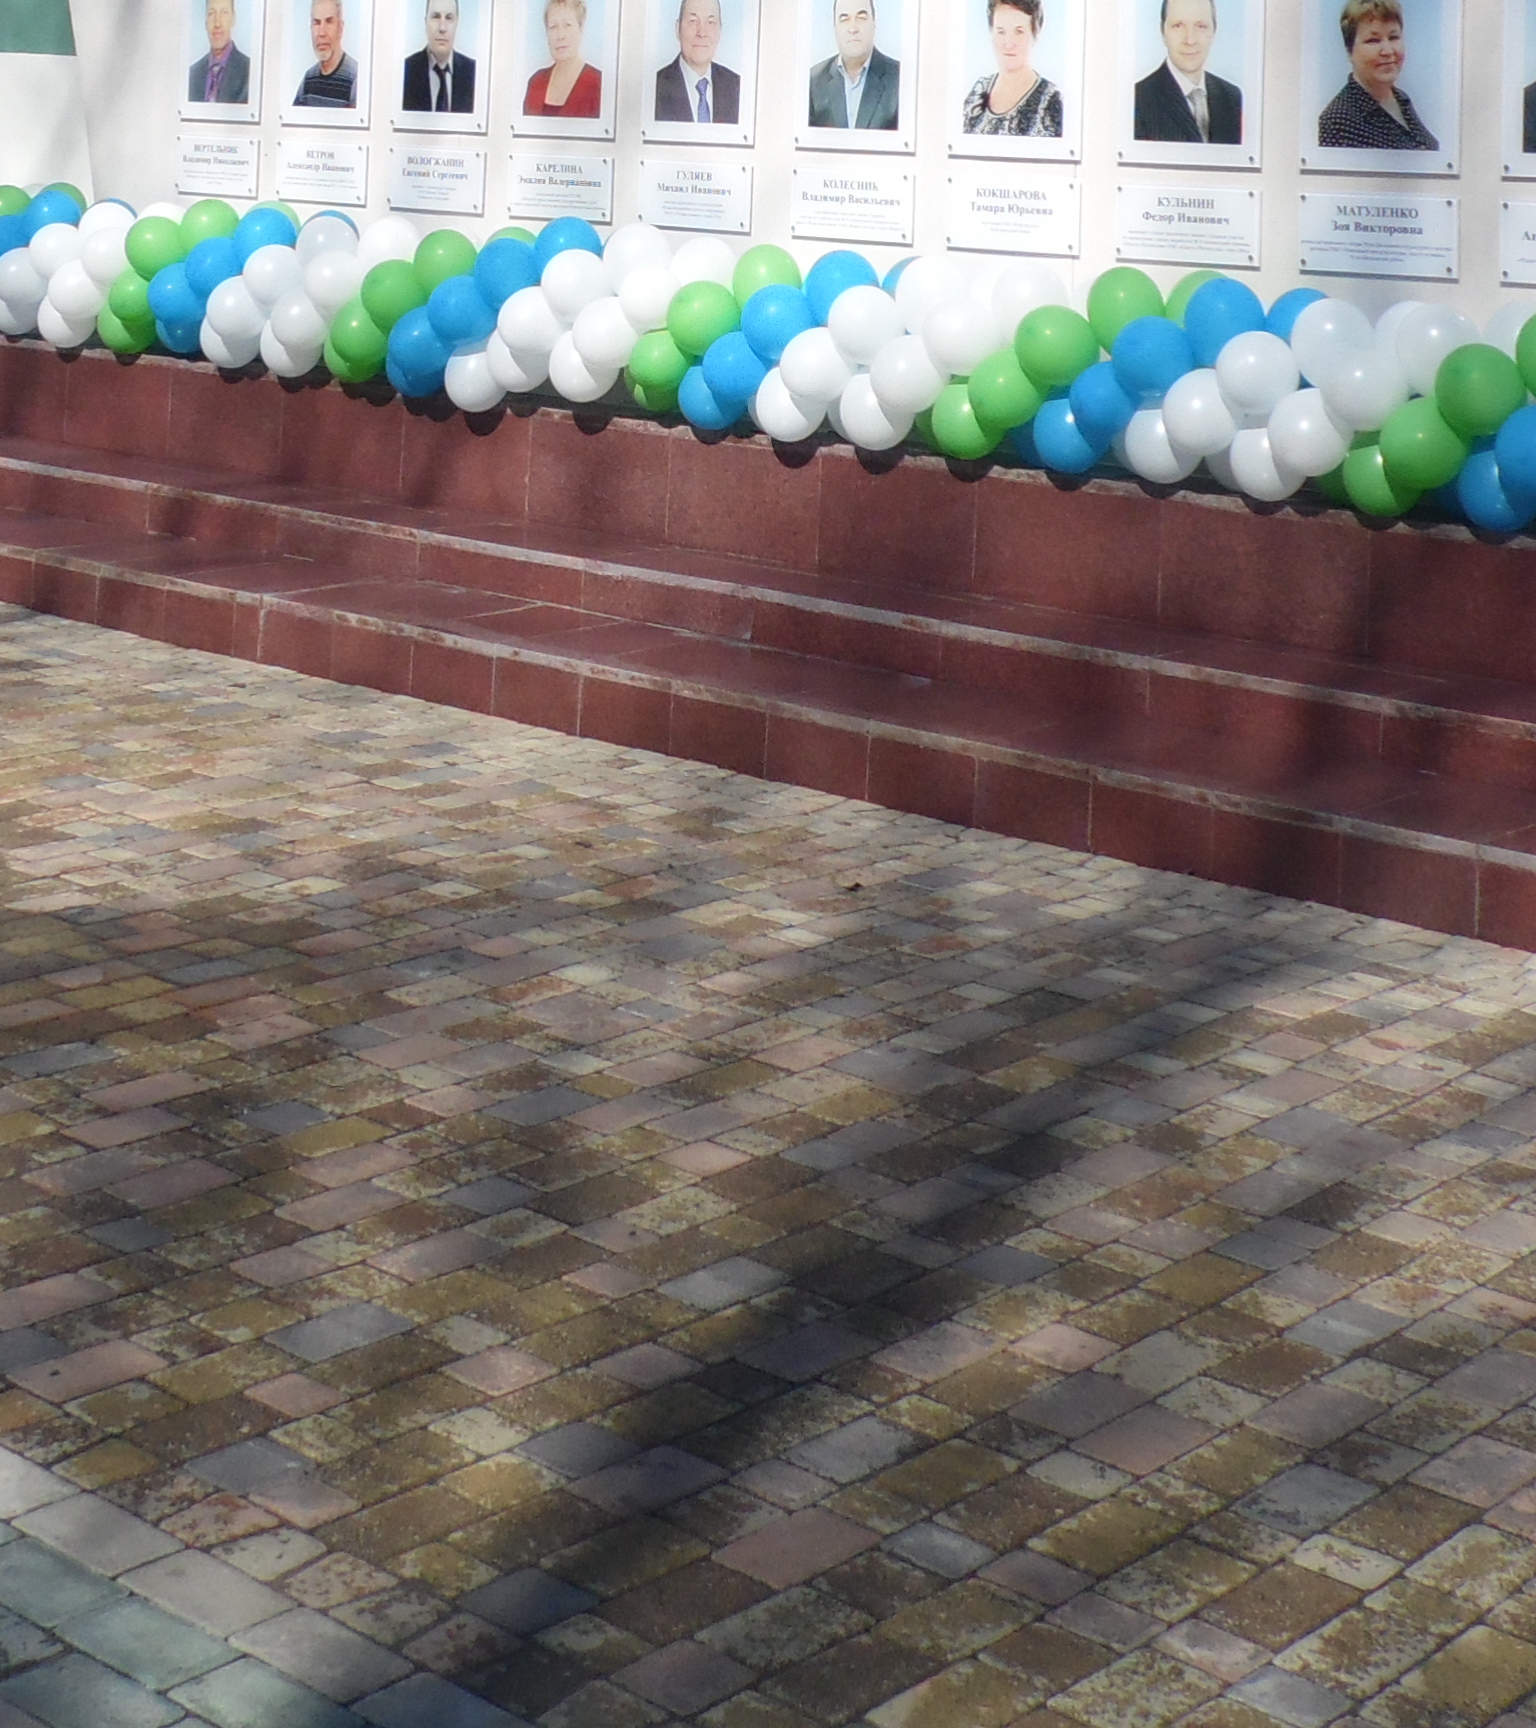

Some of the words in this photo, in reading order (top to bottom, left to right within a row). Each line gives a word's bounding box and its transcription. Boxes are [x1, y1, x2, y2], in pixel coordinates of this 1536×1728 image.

[536, 163, 583, 174] КАРЕЛИНА
[676, 170, 713, 181] ГУЛЯЕВ
[657, 182, 689, 194] Михаил
[823, 178, 879, 191] КОЛЕСНИК
[802, 191, 846, 204] Владимир
[848, 193, 901, 207] Васильевич
[975, 187, 1047, 201] КОКШАРОВА
[970, 201, 1005, 215] Тамара
[1007, 203, 1053, 217] Юрьевна
[1157, 196, 1215, 209] КУЛЬНИН
[1177, 212, 1230, 225] Иванович
[1336, 205, 1419, 219] МАТУЛЕНКО
[1332, 220, 1351, 232] Зоя
[1354, 221, 1424, 236] Викторовна
